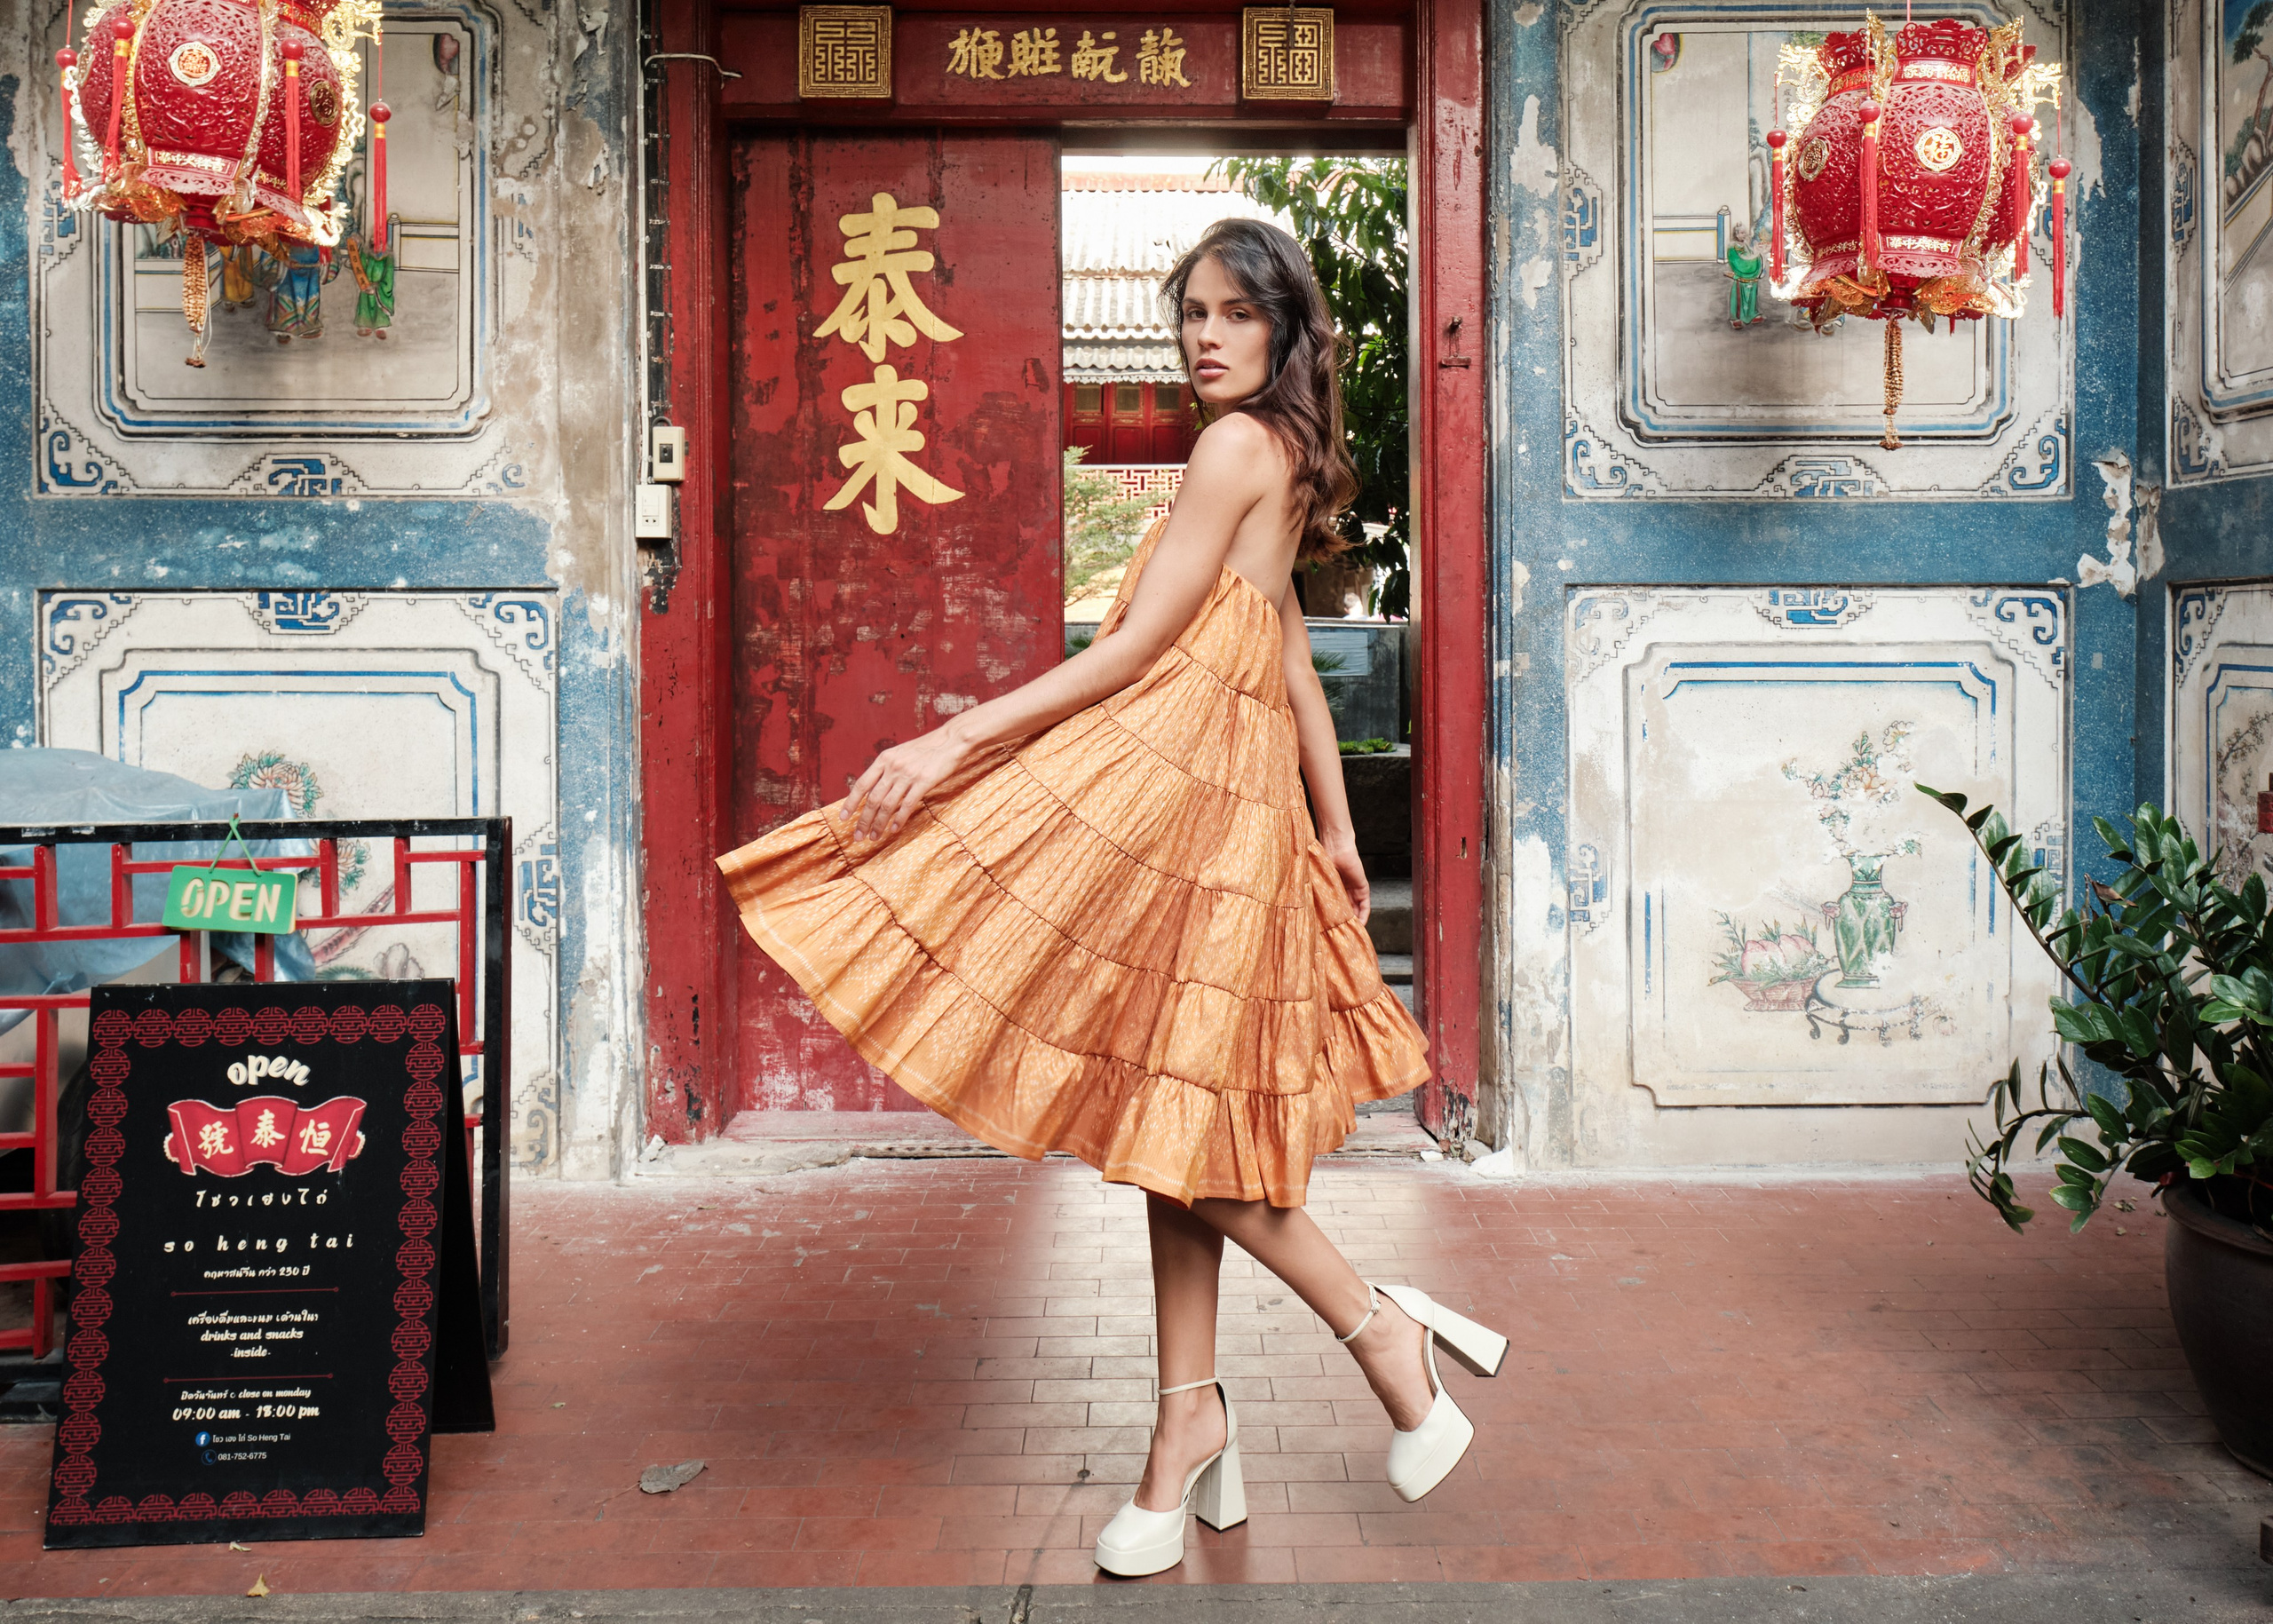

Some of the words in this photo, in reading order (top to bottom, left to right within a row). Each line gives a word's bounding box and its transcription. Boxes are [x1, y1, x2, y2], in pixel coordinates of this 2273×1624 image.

[181, 877, 281, 923] OPEN
[227, 1055, 311, 1086] open
[163, 1240, 194, 1252] so
[217, 1234, 289, 1253] heng
[310, 1232, 353, 1248] tai
[302, 1264, 311, 1276] ปี
[201, 1329, 237, 1342] drinks
[239, 1328, 262, 1341] and
[265, 1327, 304, 1340] snacks
[238, 1388, 260, 1398] close
[275, 1387, 312, 1399] monday
[172, 1406, 216, 1421] 09:00
[218, 1409, 242, 1420] am
[297, 1406, 320, 1419] pm
[258, 1434, 278, 1443] Heng
[218, 1452, 267, 1461] 081-752-6775
